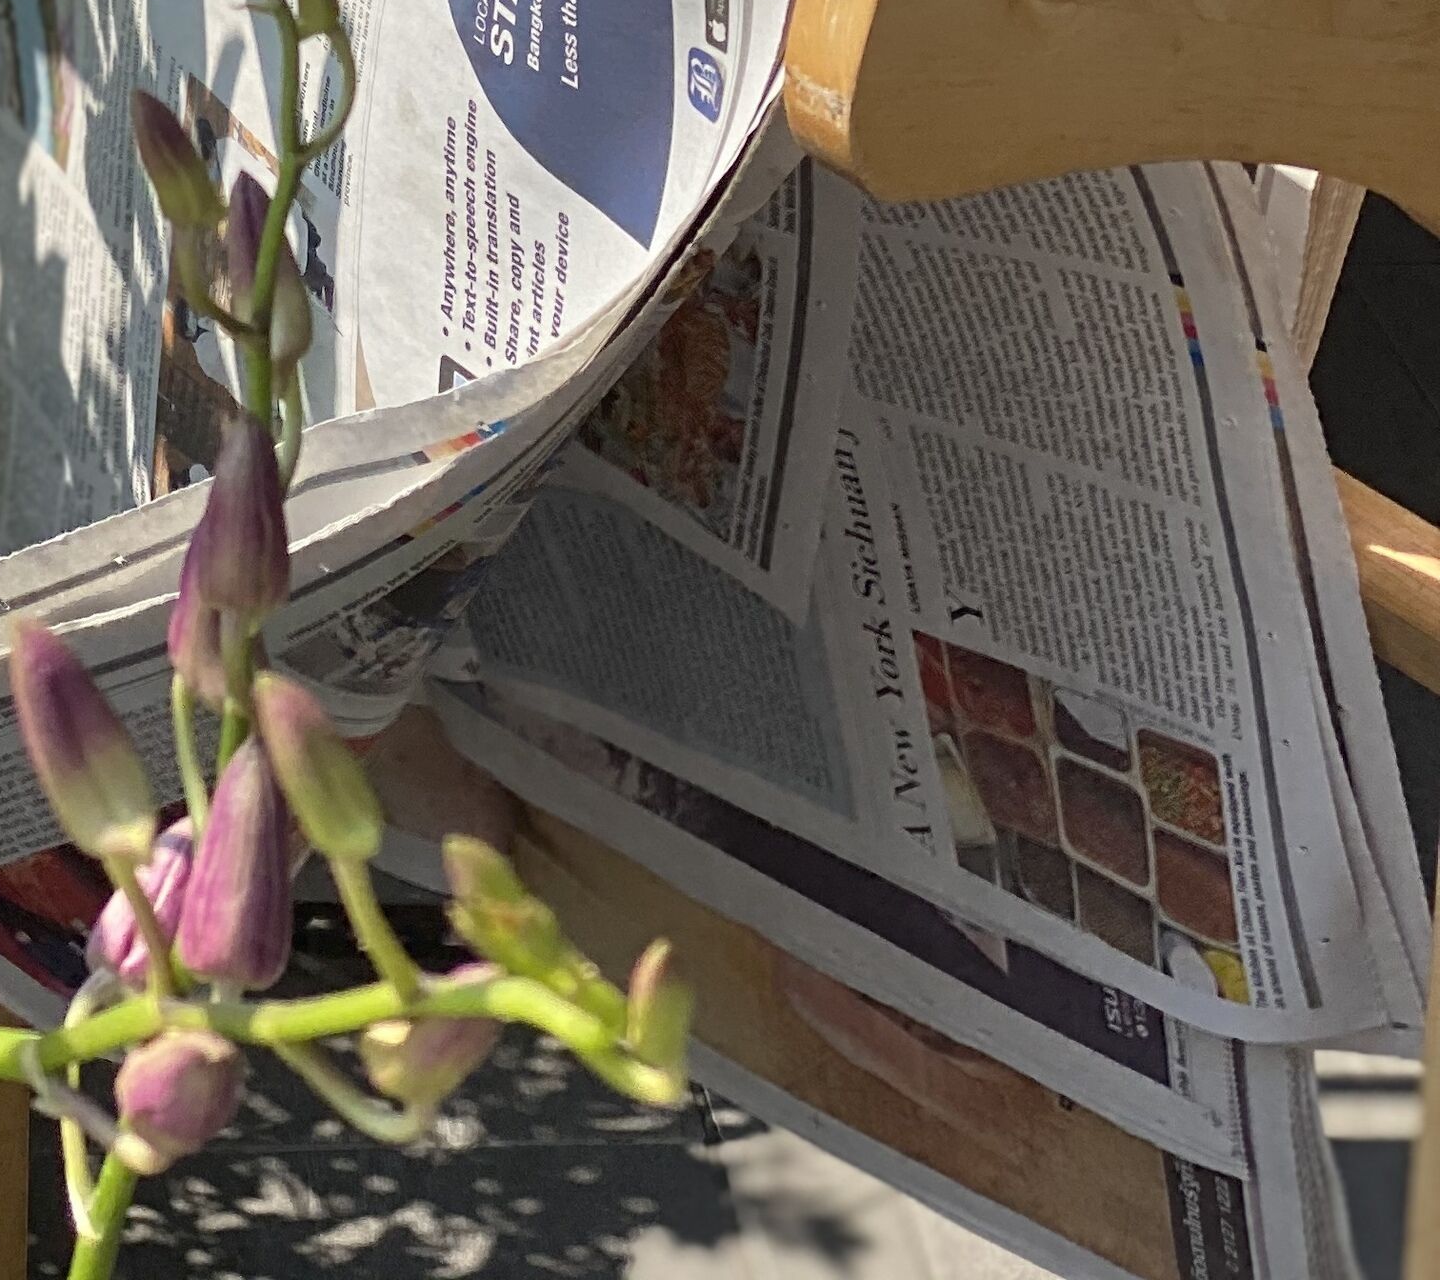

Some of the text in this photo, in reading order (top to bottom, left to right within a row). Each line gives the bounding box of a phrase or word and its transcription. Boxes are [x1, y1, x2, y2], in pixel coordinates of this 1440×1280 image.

[561, 33, 579, 90] Less
[344, 153, 354, 207] province.
[440, 116, 458, 322] Anywhere, anytime
[462, 99, 479, 333] Text-to-speech engine
[484, 148, 499, 350] Built-in translation
[505, 191, 525, 366] Share, copy and
[527, 239, 546, 359] int articles
[555, 211, 570, 285] device
[820, 445, 886, 609] Sichuan
[859, 611, 905, 711] York
[878, 717, 925, 813] New
